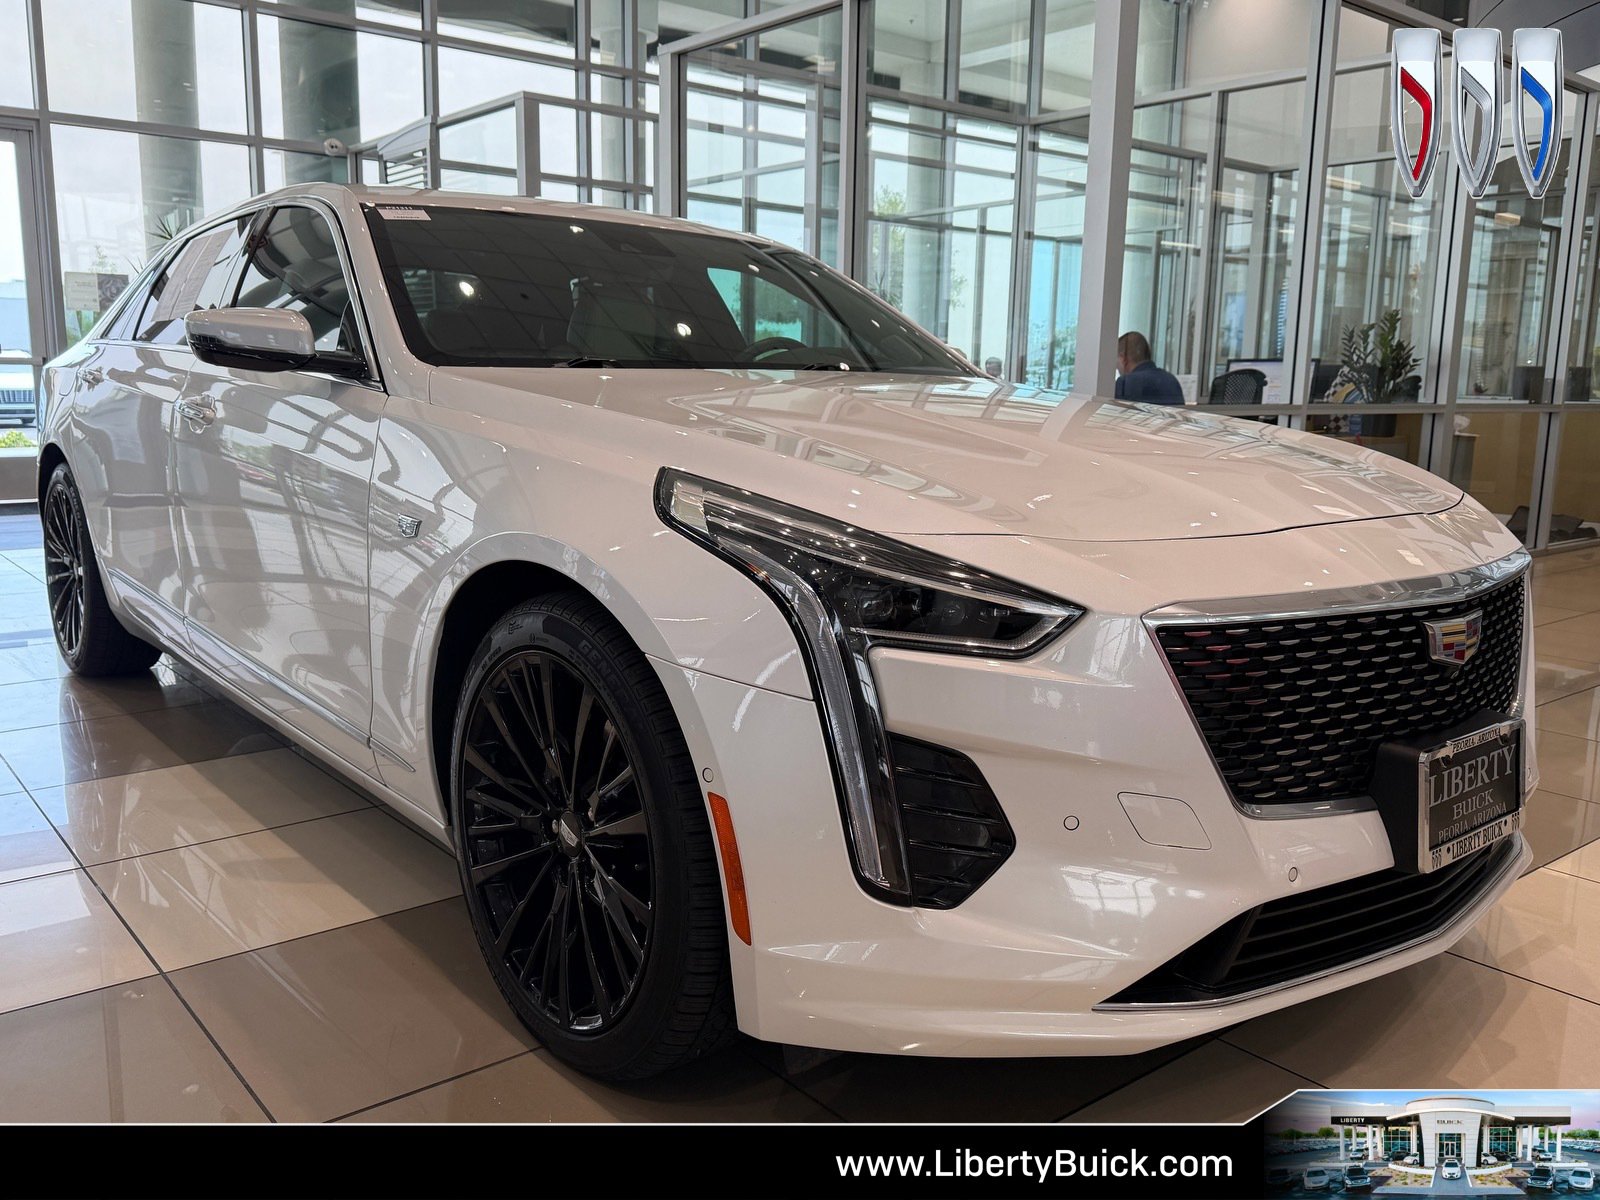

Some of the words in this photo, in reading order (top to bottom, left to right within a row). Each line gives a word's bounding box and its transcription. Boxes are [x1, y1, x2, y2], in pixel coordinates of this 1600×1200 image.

[1478, 727, 1501, 743] ARIZONA
[1429, 744, 1516, 807] LIBERTY
[1452, 789, 1494, 820] BUICK
[1473, 802, 1507, 827] ARIZONA
[1451, 830, 1482, 860] LIBERTY
[1482, 820, 1504, 845] BUICK
